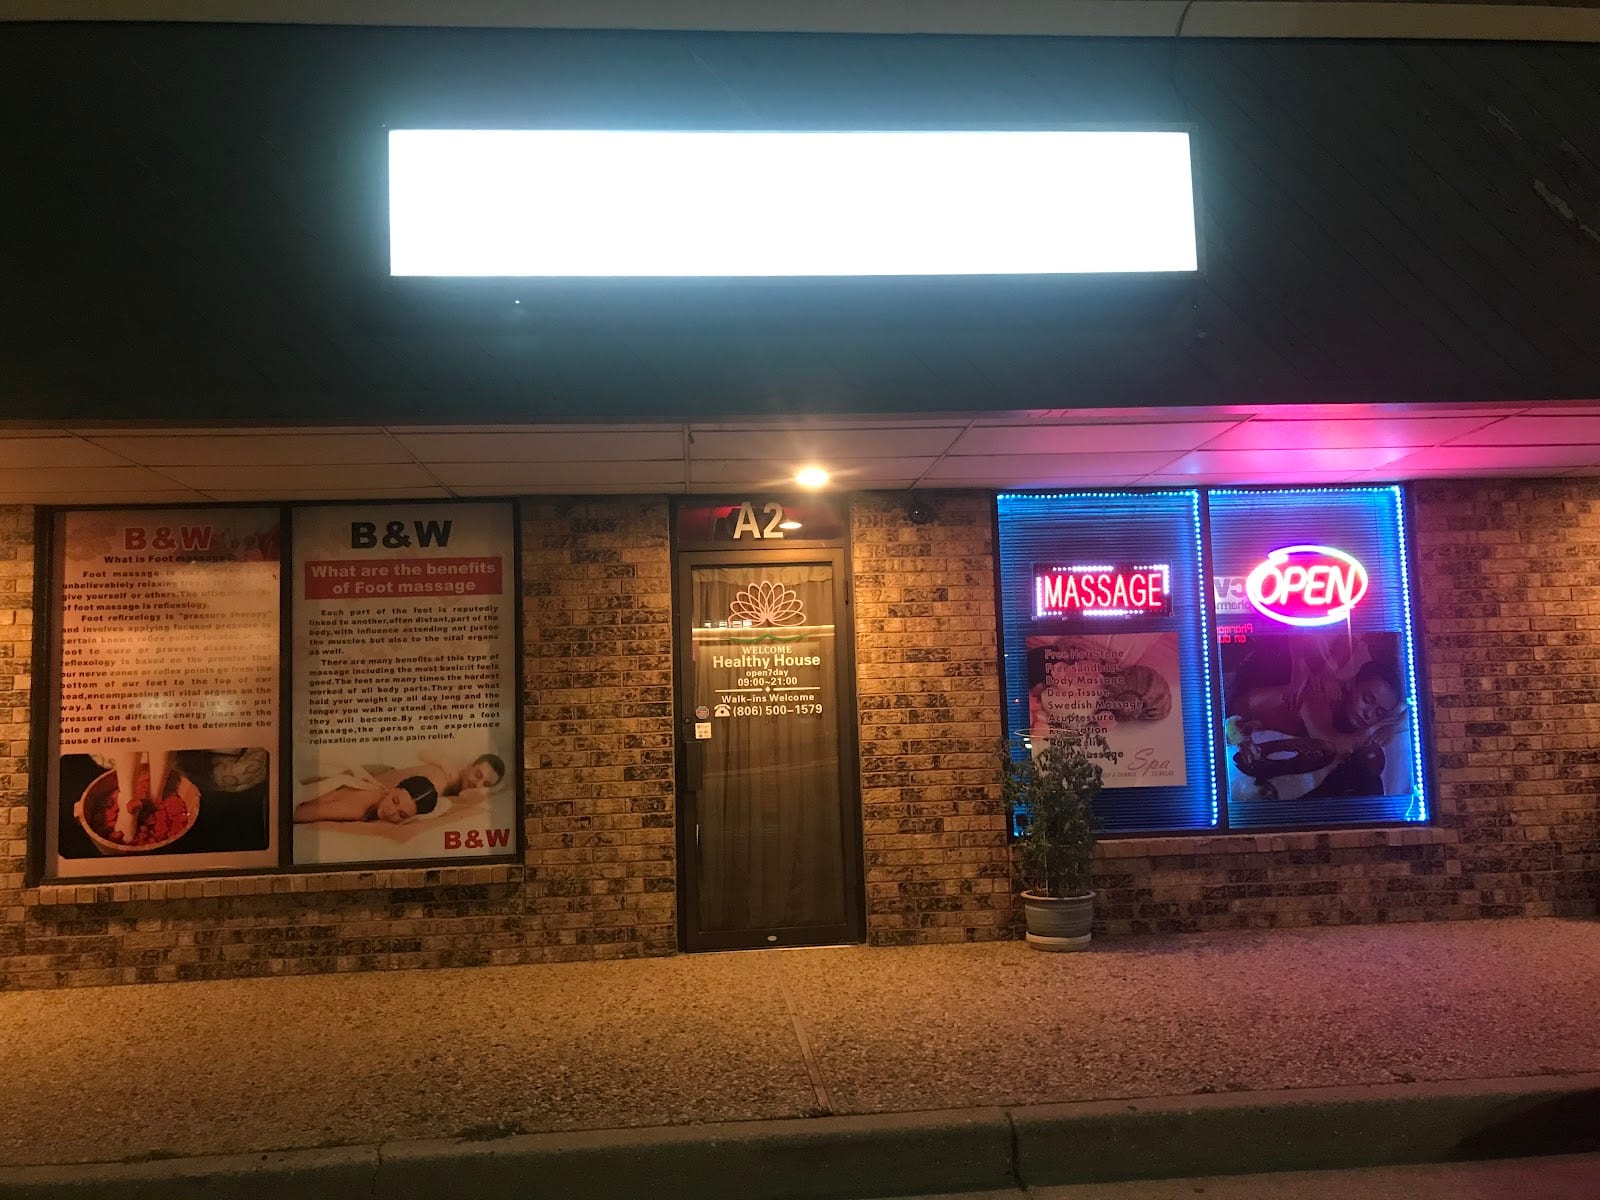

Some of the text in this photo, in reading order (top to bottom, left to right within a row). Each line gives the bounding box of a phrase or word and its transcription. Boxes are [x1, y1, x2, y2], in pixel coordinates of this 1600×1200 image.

[732, 501, 785, 539] A2
[124, 526, 212, 551] B&W
[351, 520, 453, 549] B&W
[147, 554, 173, 562] Foot
[82, 570, 107, 578] Foot
[311, 561, 497, 578] What are the benefits
[331, 580, 478, 595] of Foot massage
[1043, 573, 1162, 609] MASSAGE
[1258, 564, 1357, 608] OPEN
[349, 608, 370, 617] part
[452, 605, 500, 613] reputedly
[80, 614, 103, 622] Foot
[350, 617, 413, 625] another,often
[414, 615, 470, 623] distant,part
[308, 628, 354, 636] body,with
[356, 626, 399, 634] influence
[402, 625, 449, 634] extending
[308, 638, 324, 646] the
[369, 636, 385, 644] but
[467, 634, 500, 642] organs
[321, 647, 346, 655] well.
[742, 645, 792, 655] WELCOME
[1044, 648, 1070, 660] Free
[320, 658, 348, 666] There
[394, 655, 433, 663] benefits
[446, 654, 465, 662] this
[466, 654, 487, 662] type
[712, 653, 821, 670] Healthy House
[308, 669, 350, 677] massage
[352, 666, 395, 675] including
[476, 662, 501, 670] feels
[745, 669, 789, 678] open7day
[1045, 662, 1069, 674] Free
[308, 677, 352, 687] good.The
[392, 676, 417, 684] many
[463, 672, 501, 680] hardest
[1046, 675, 1126, 687] Body Massage
[376, 686, 400, 694] body
[403, 683, 454, 693] parts.They
[1047, 687, 1110, 699] Deep Tissue
[308, 693, 461, 706] hold your weight long
[721, 692, 815, 704] Walk-ins Welcome
[308, 708, 339, 716] longer
[361, 705, 384, 713] walk
[400, 704, 427, 712] stand
[429, 703, 448, 711] ,the
[477, 701, 501, 709] tired
[732, 703, 823, 718] (806) 500-1579
[1047, 699, 1144, 711] Swedish Massage
[309, 710, 501, 726] they will become.By receiving foot
[1048, 713, 1115, 724] Acupressure
[308, 726, 374, 735] massage,the
[309, 736, 358, 744] relaxation
[405, 734, 426, 742] pain
[427, 732, 456, 740] relief.
[1127, 747, 1172, 776] Spa
[444, 828, 511, 849] B&W
